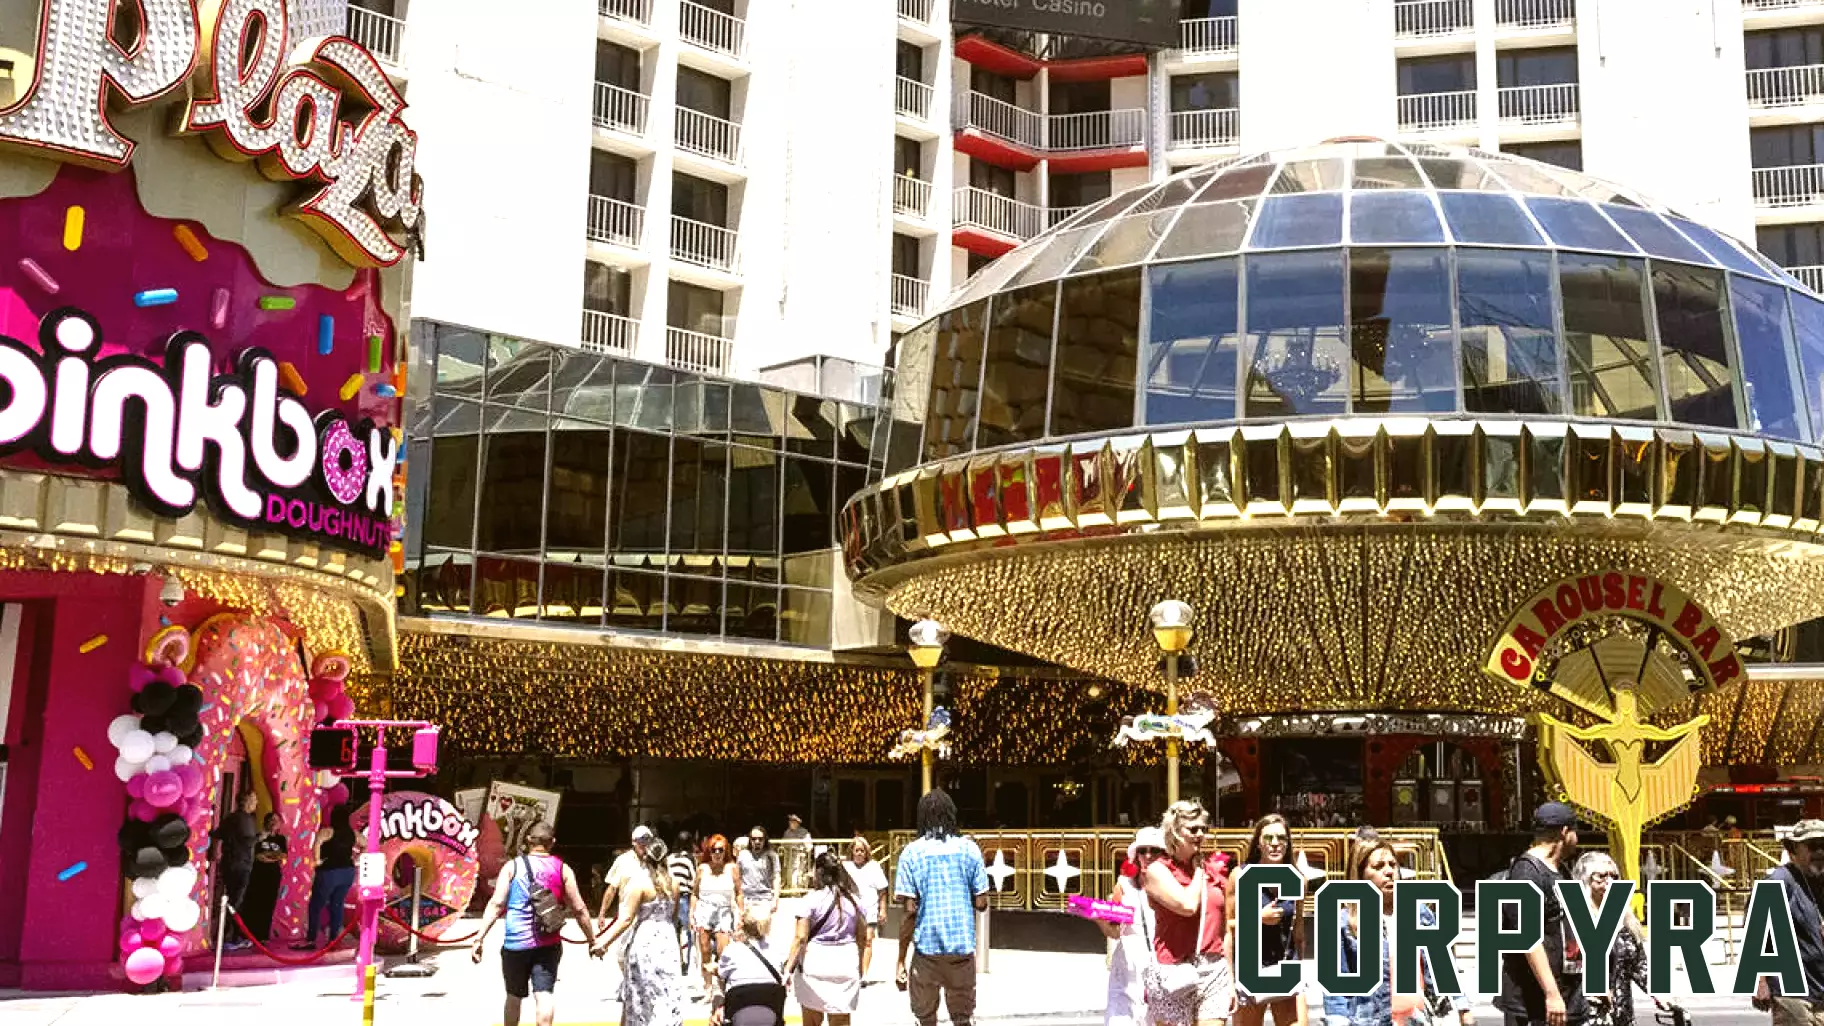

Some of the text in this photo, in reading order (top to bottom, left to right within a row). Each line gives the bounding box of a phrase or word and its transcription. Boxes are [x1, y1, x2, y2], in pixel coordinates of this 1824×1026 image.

[1033, 0, 1105, 17] Casino
[0, 0, 425, 268] Plaza
[1500, 571, 1740, 687] CAROUSEL BAR
[341, 737, 352, 763] 6
[363, 801, 479, 847] inkbox
